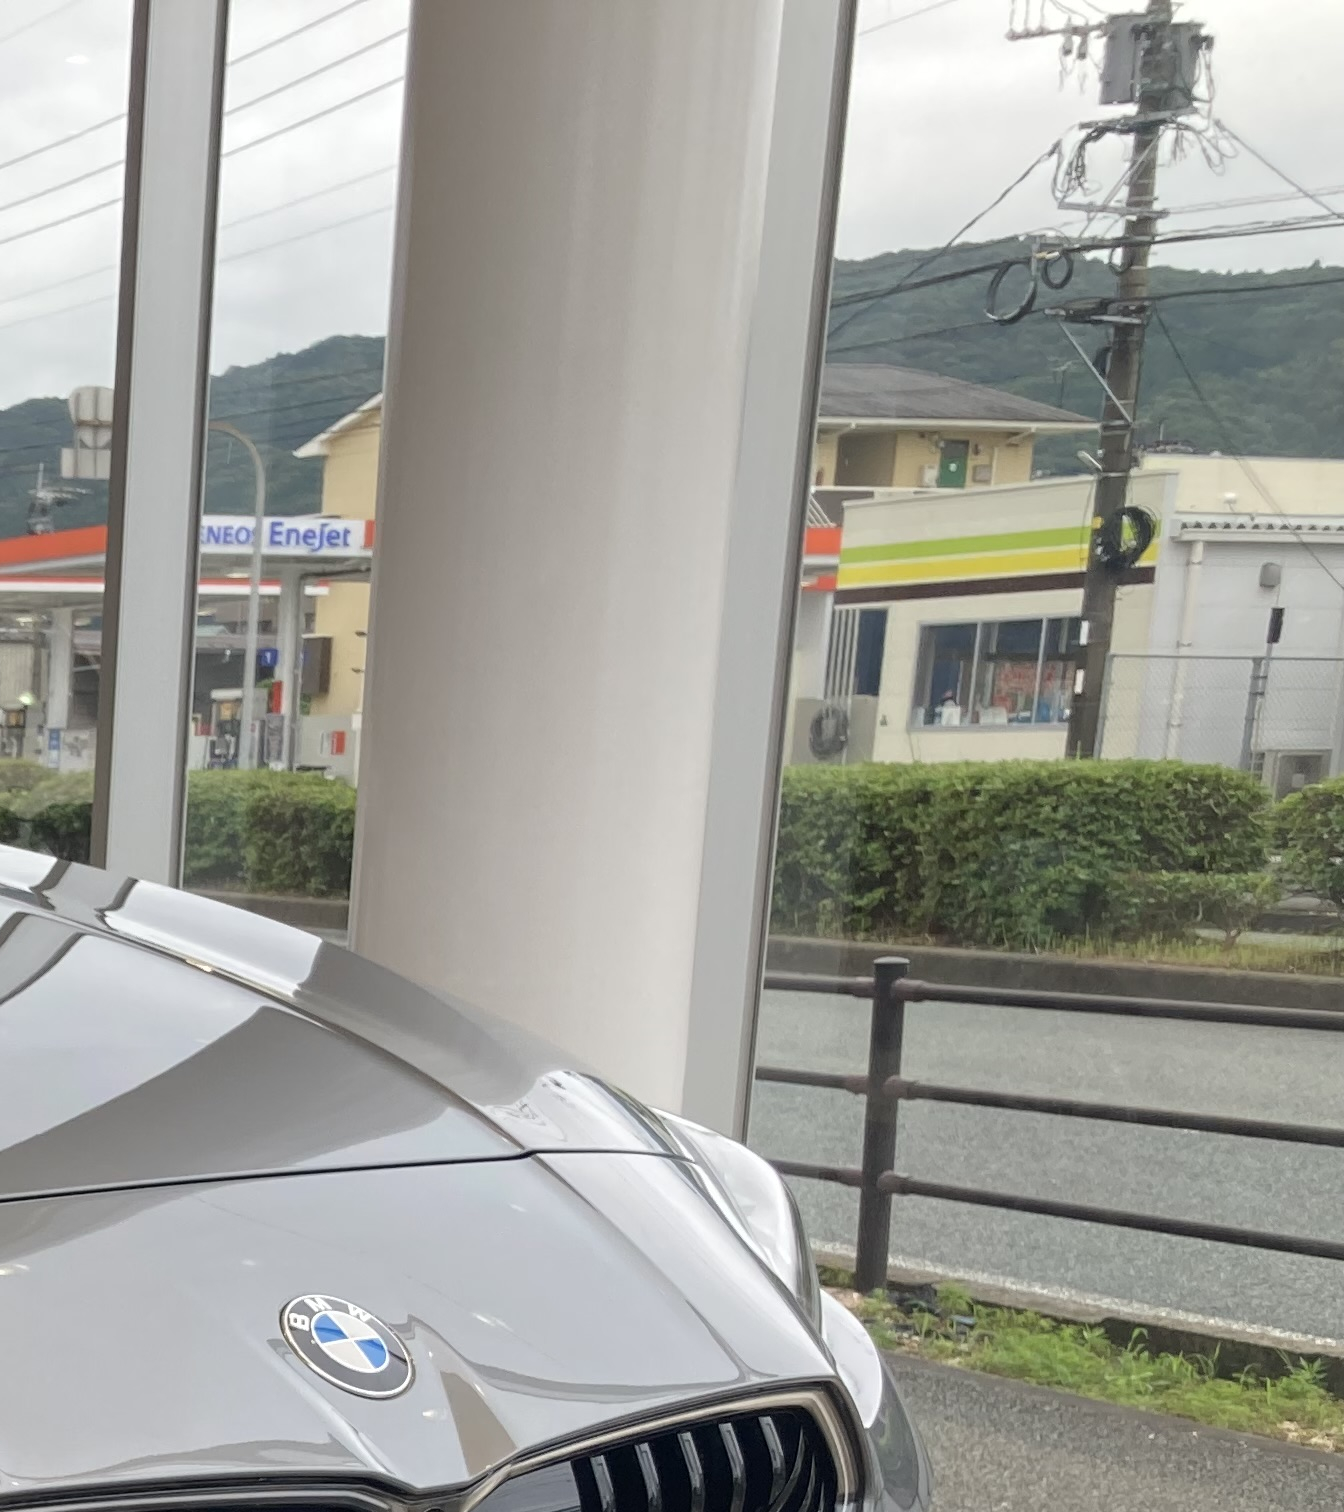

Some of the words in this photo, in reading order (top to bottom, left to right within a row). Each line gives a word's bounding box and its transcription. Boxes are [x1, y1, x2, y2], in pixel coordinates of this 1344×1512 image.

[201, 525, 256, 545] NEO
[269, 521, 351, 552] EneJet
[288, 1296, 373, 1332] BMW
